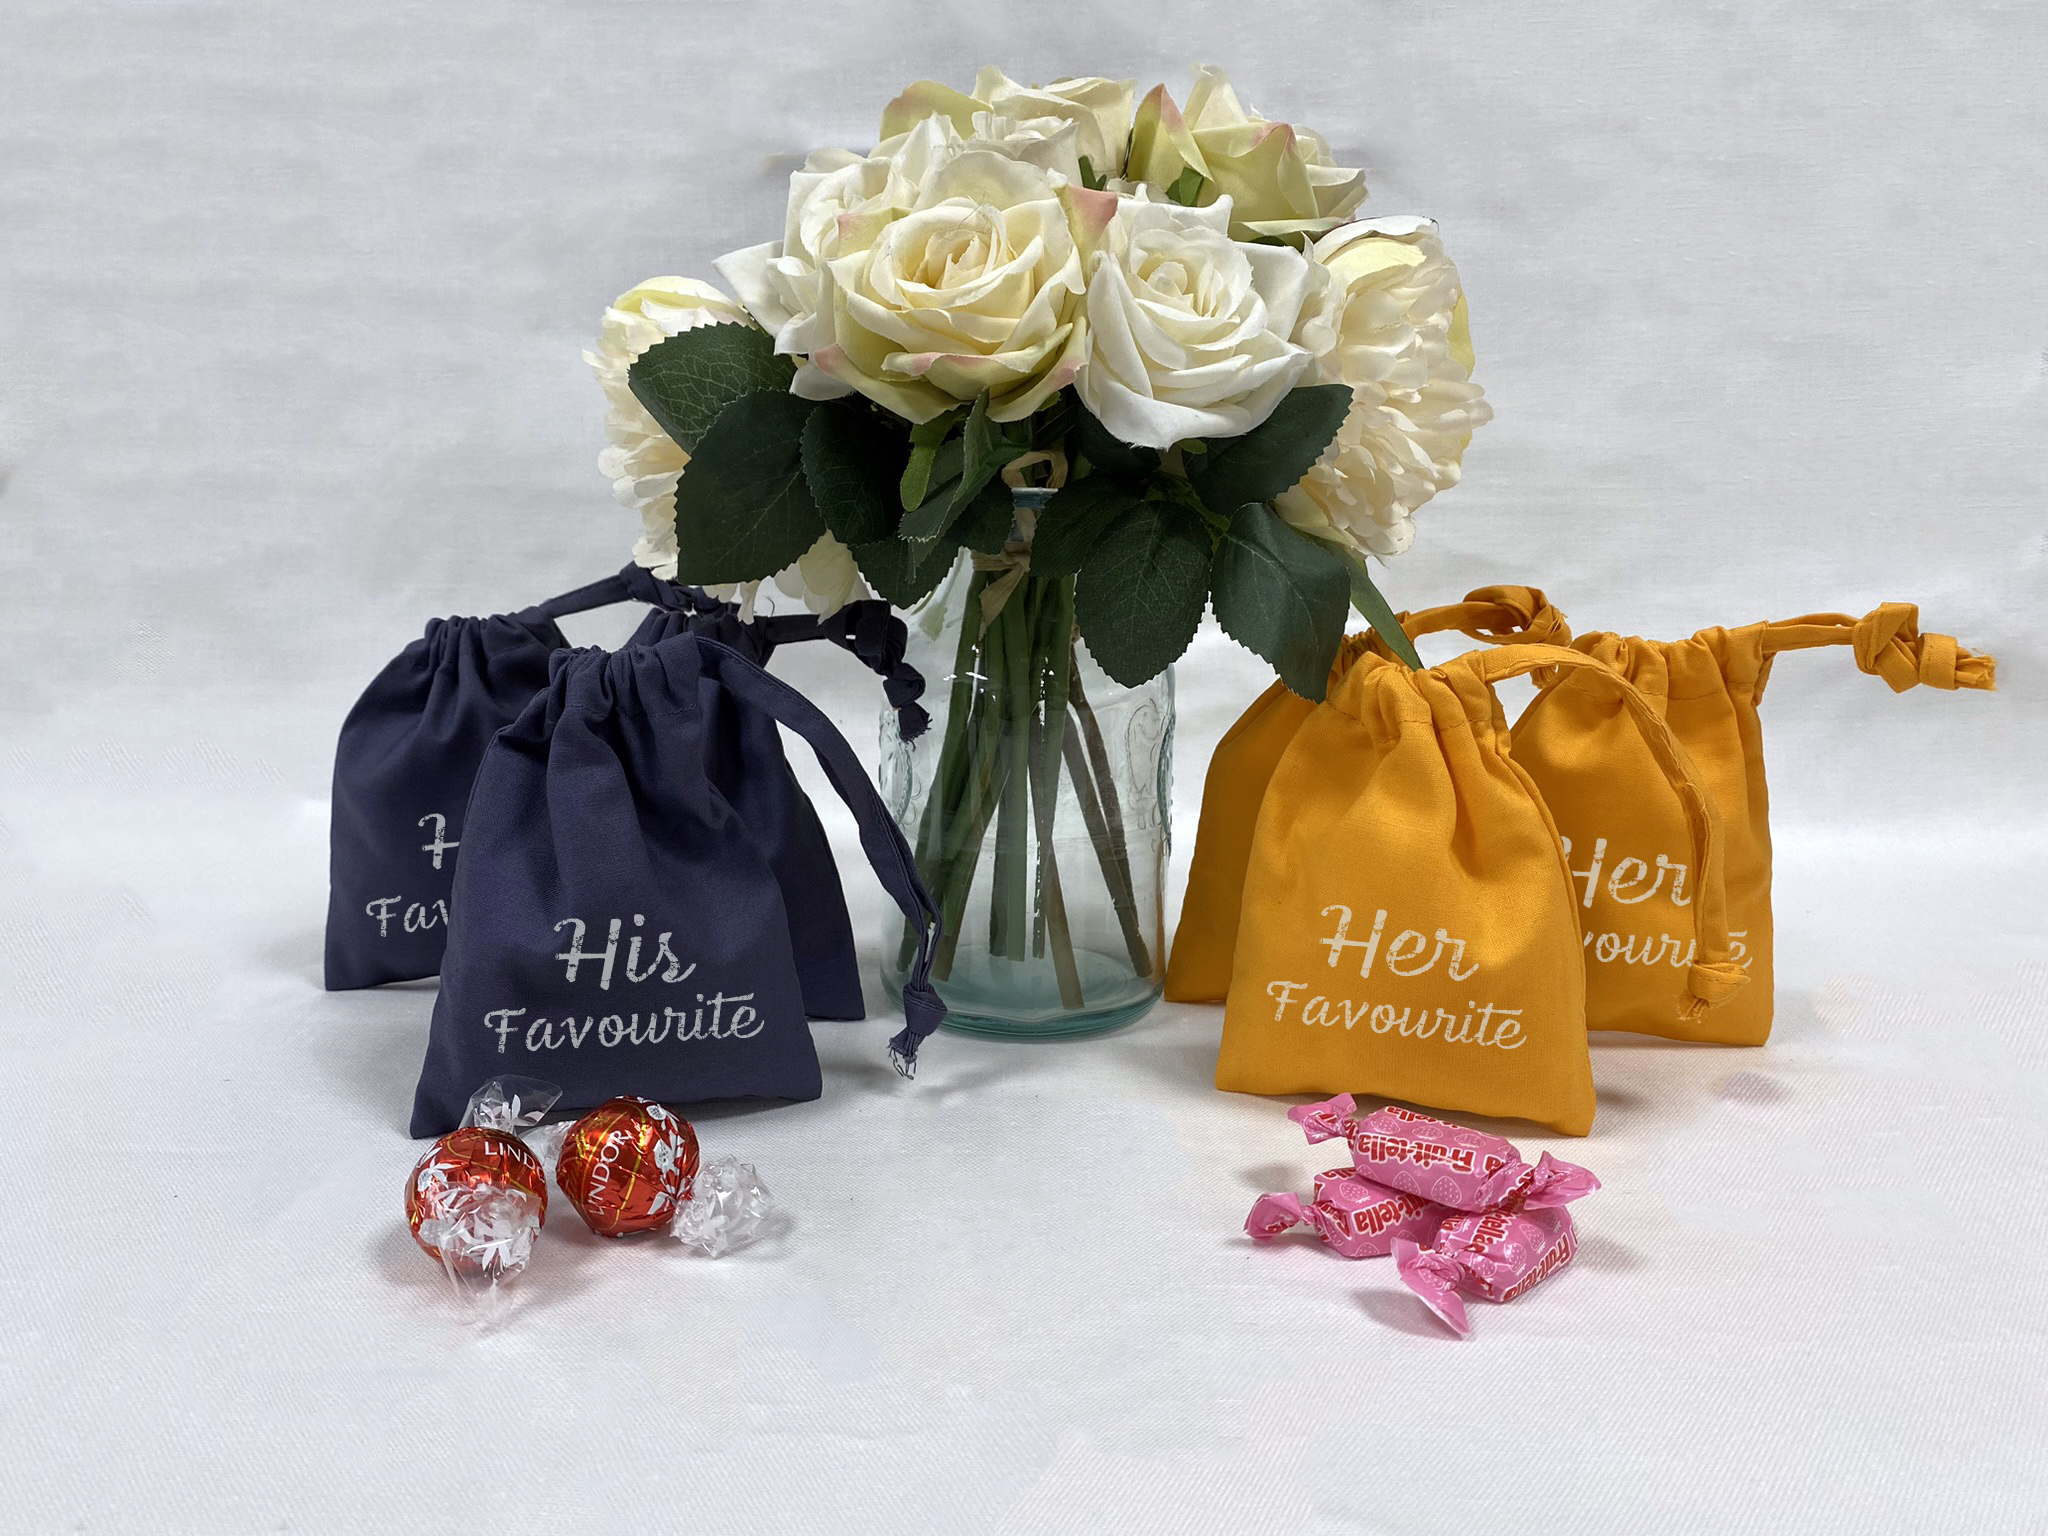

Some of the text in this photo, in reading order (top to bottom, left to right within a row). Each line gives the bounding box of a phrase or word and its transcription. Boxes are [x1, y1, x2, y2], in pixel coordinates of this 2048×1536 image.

[552, 914, 697, 990] His
[1320, 904, 1480, 982] Her
[483, 992, 764, 1053] Favourite
[1266, 980, 1527, 1050] Favourite
